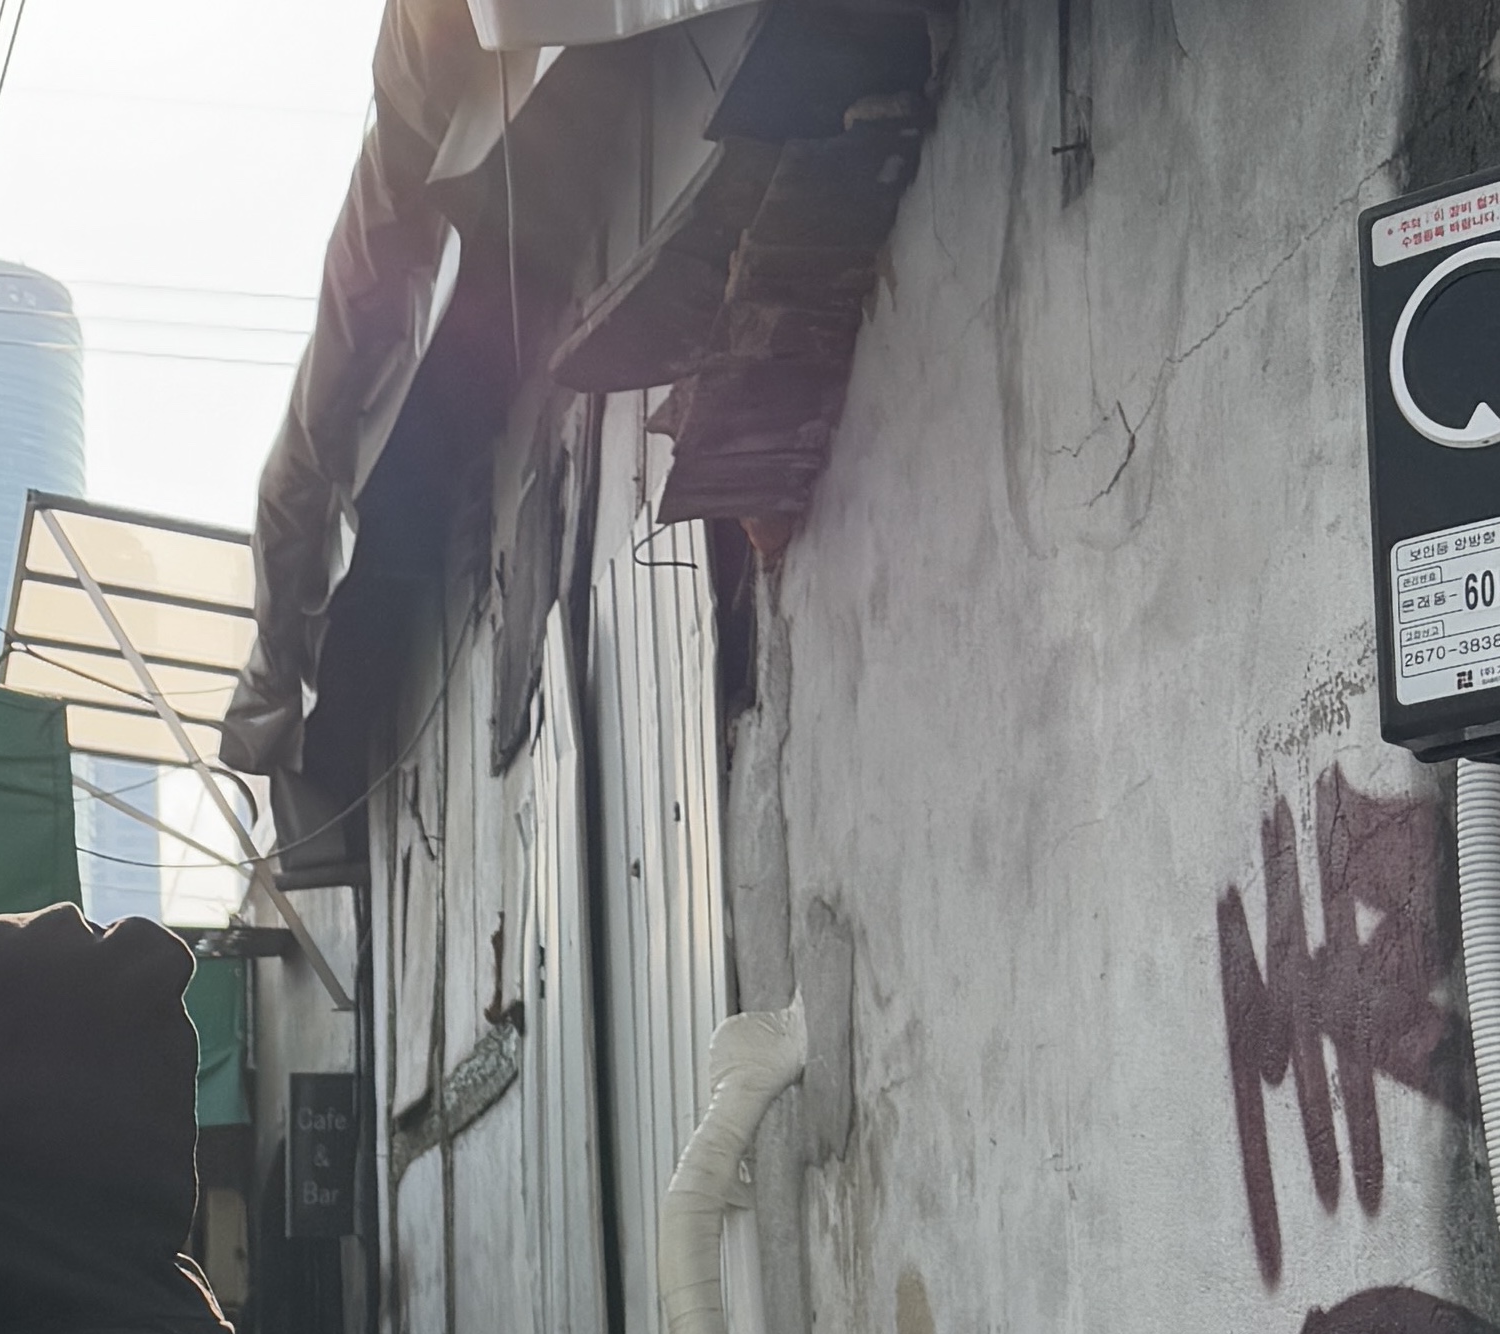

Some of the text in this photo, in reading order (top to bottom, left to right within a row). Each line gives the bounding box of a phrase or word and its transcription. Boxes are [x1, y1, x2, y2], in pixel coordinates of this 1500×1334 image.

[1410, 541, 1448, 562] 보안등
[1465, 570, 1495, 610] 60
[1404, 633, 1500, 667] 2670-3838
[298, 1106, 347, 1131] Cafe
[313, 1143, 330, 1167] &
[303, 1180, 339, 1205] Bar
